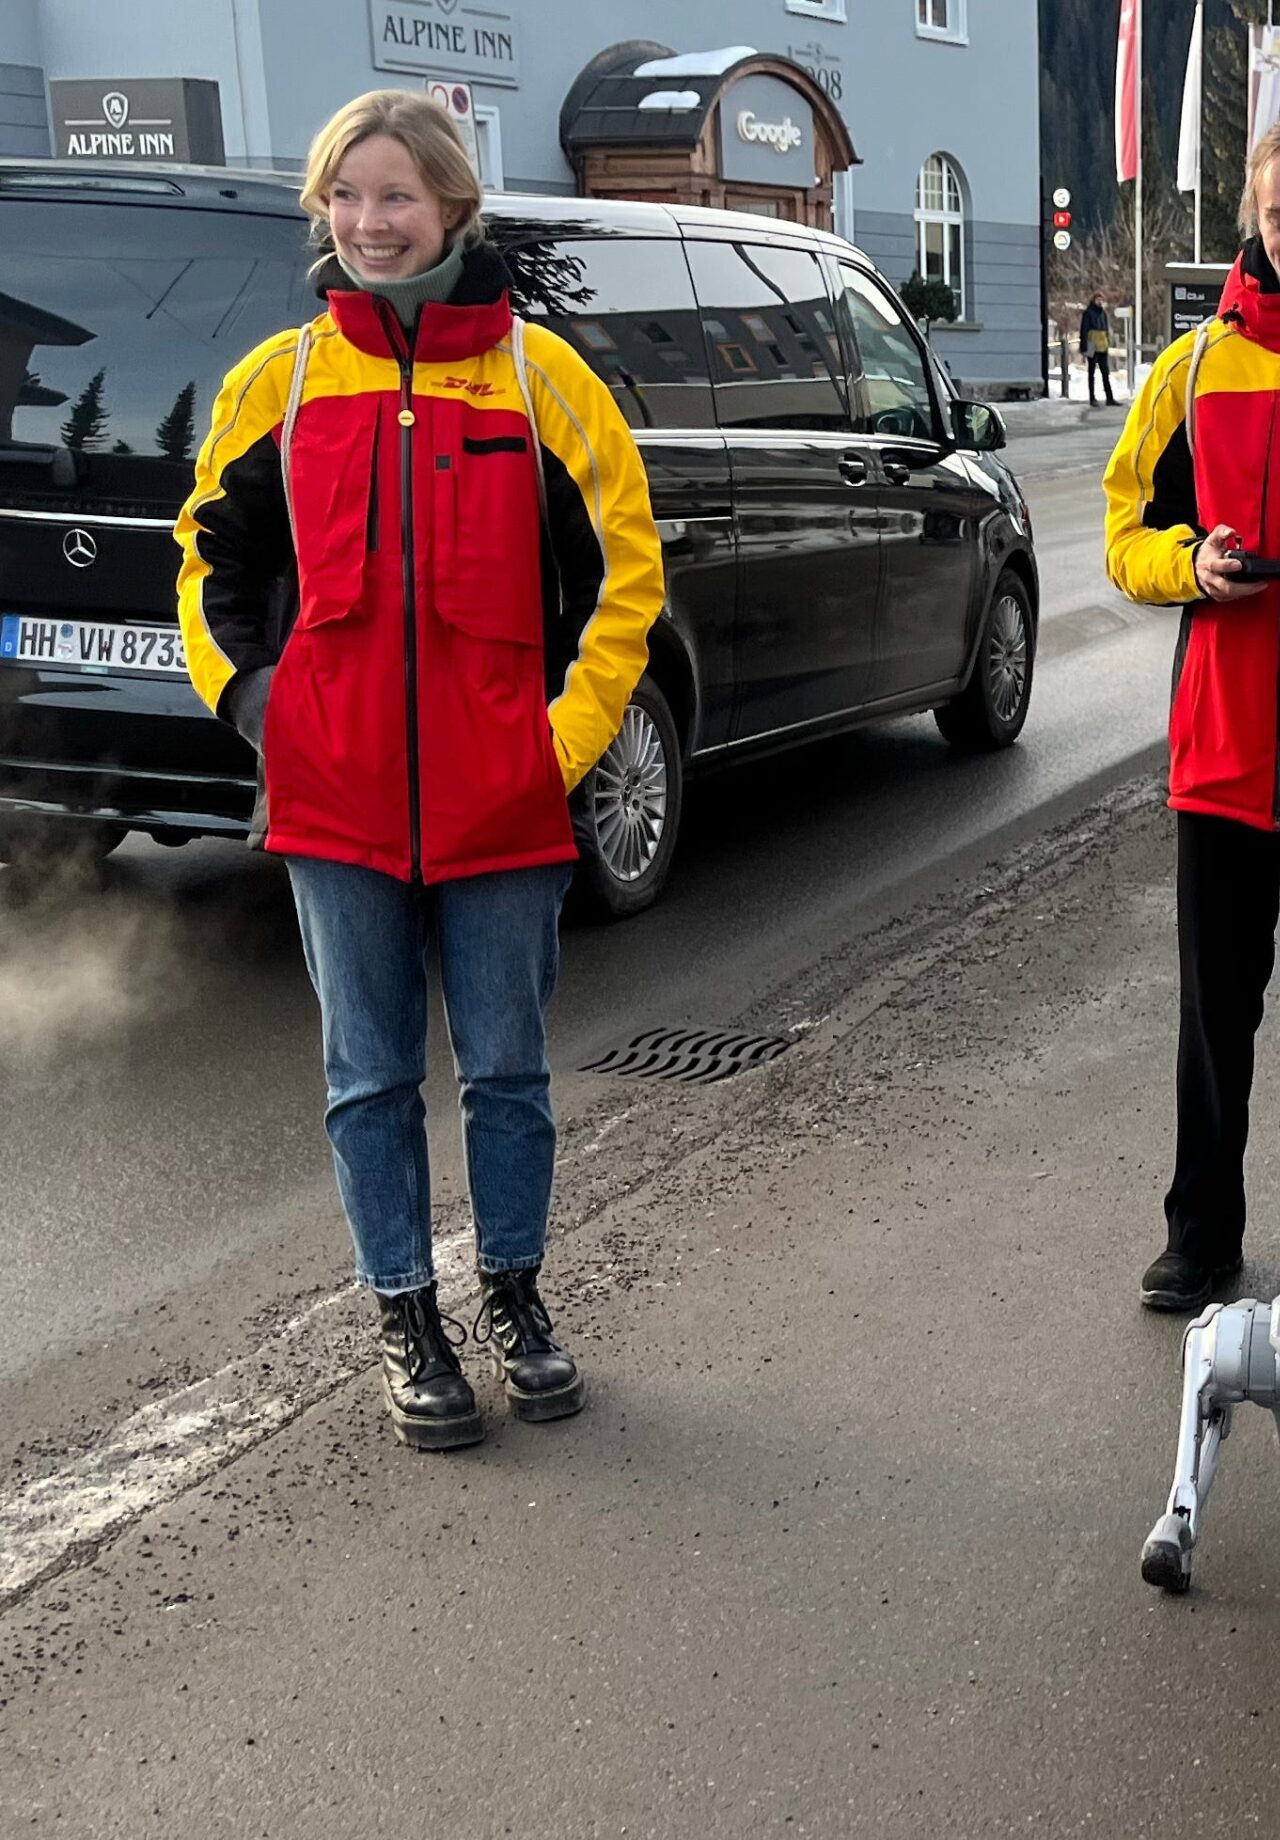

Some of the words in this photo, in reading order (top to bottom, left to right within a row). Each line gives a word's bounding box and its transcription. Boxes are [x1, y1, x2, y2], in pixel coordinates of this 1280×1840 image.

[383, 15, 466, 54] ALPINE
[473, 28, 513, 61] INN
[67, 133, 135, 155] ALPINE
[139, 133, 174, 155] INN
[737, 110, 801, 152] Google
[442, 376, 496, 397] DHL
[20, 622, 57, 658] HH
[79, 627, 115, 662] VW
